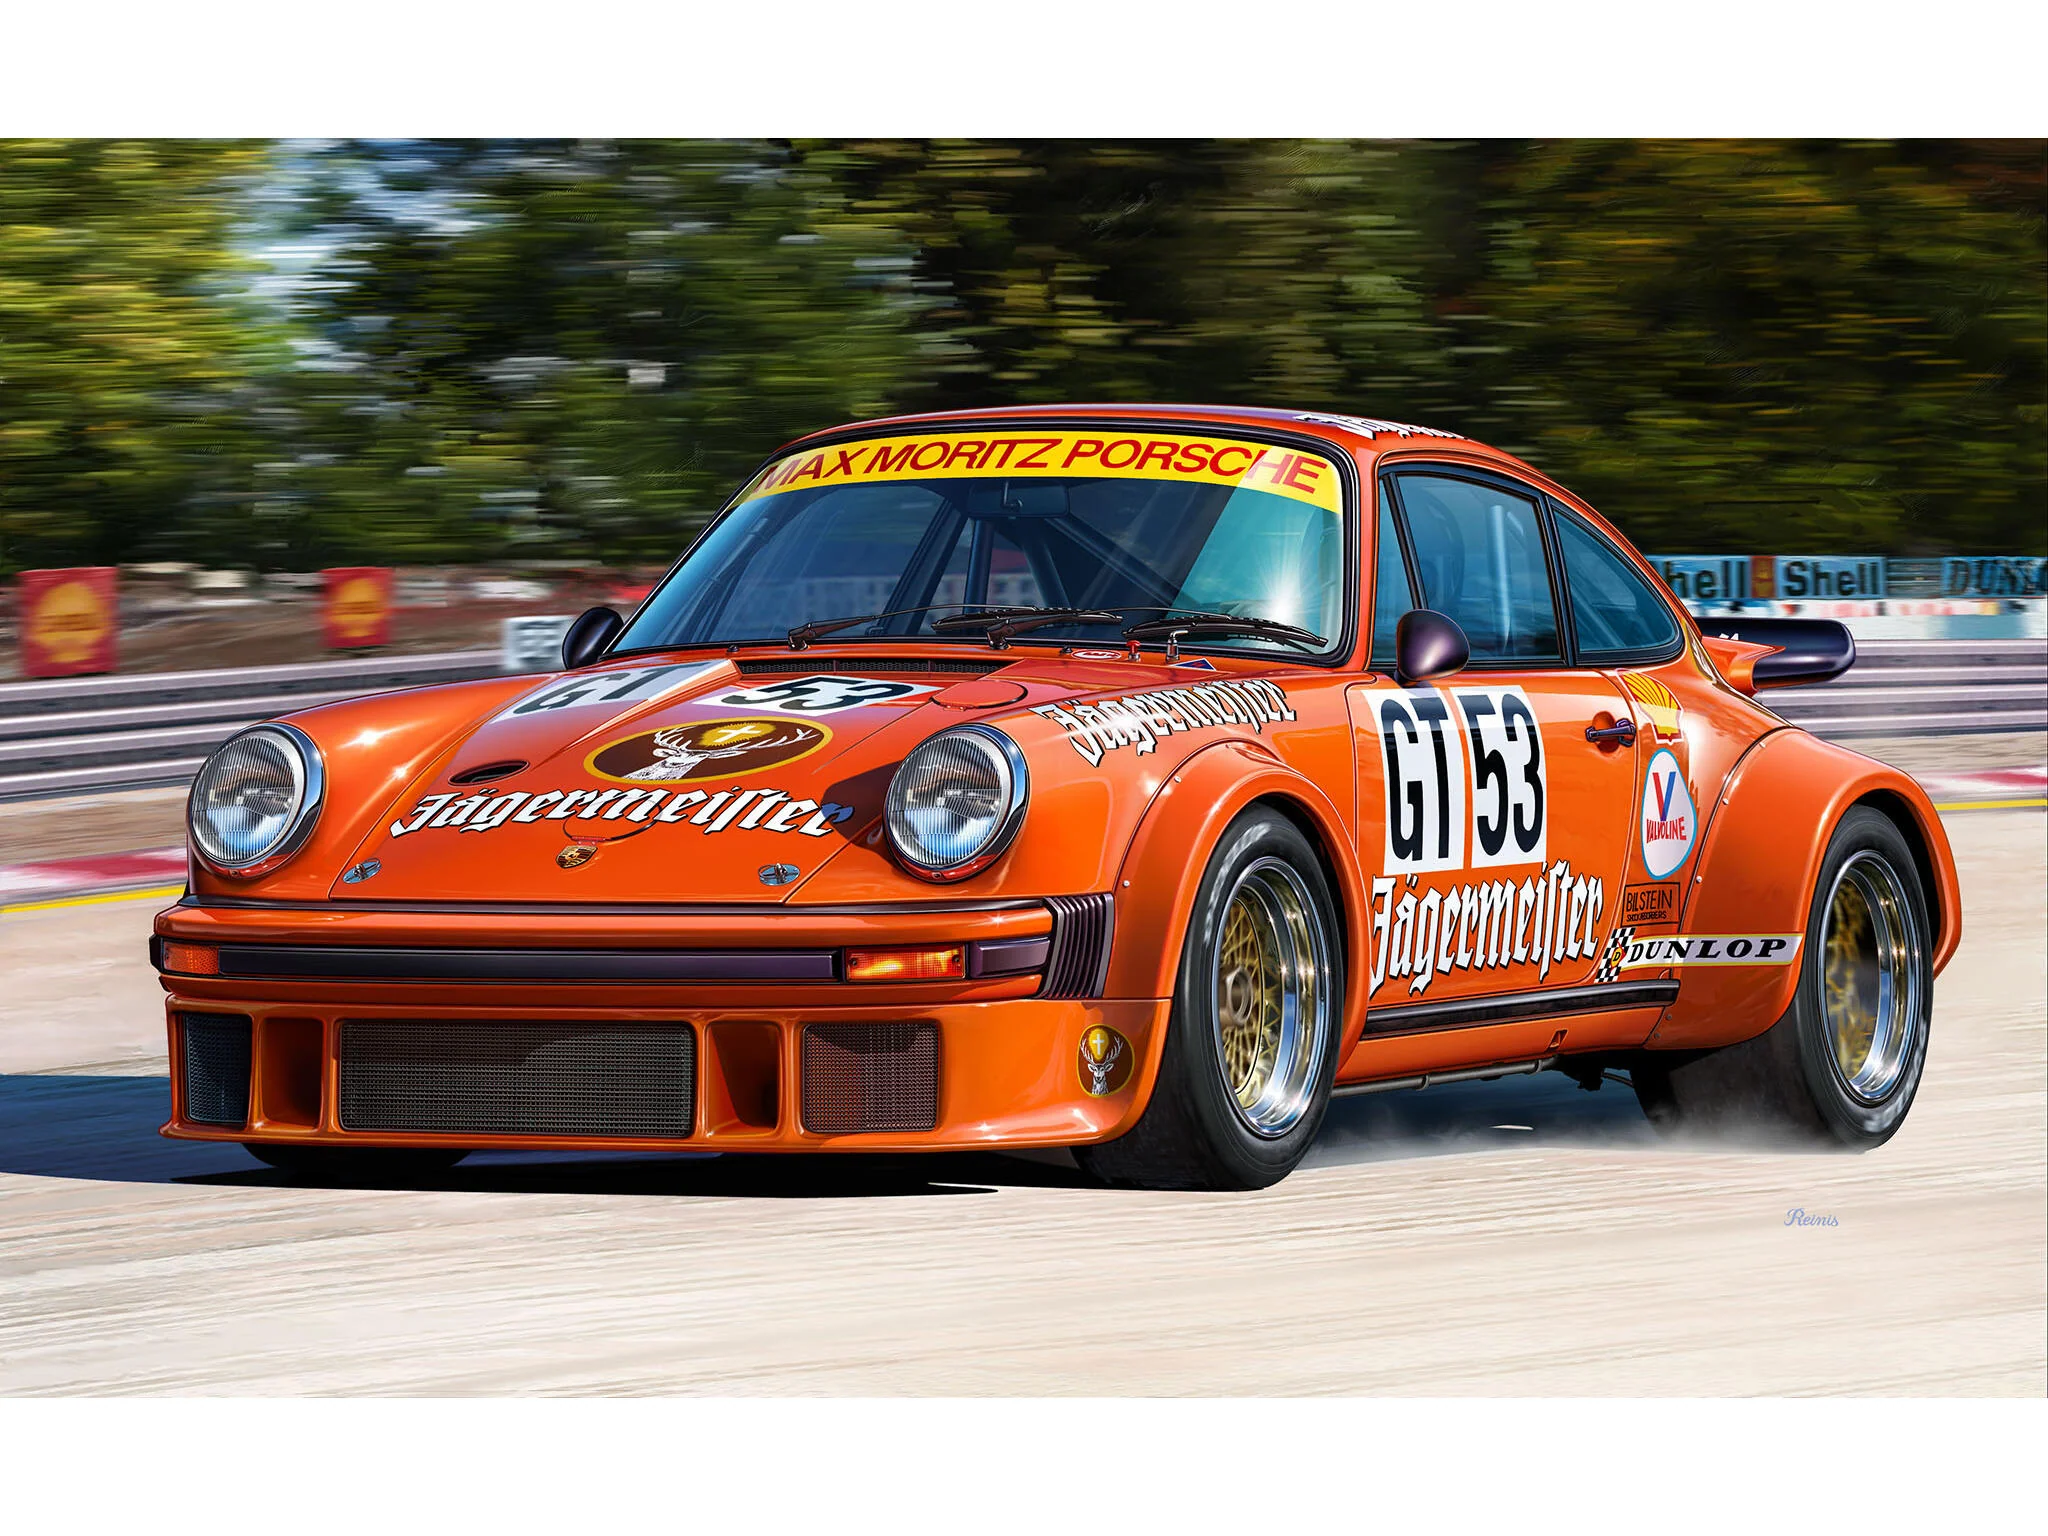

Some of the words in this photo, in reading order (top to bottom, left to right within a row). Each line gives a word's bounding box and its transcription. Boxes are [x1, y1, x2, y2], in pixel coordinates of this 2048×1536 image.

[755, 446, 869, 493] MAX
[863, 437, 1064, 475] MORITZ
[1060, 437, 1328, 495] PORSCHE
[1654, 560, 1746, 598] hell
[1784, 560, 1878, 598] Shell
[721, 676, 914, 711] 53
[1381, 695, 1449, 863] GT
[1458, 692, 1544, 857] 53
[1646, 817, 1687, 844] VALVOLINE
[1626, 889, 1673, 912] BILSTEIN
[1628, 939, 1787, 963] DUNLOP
